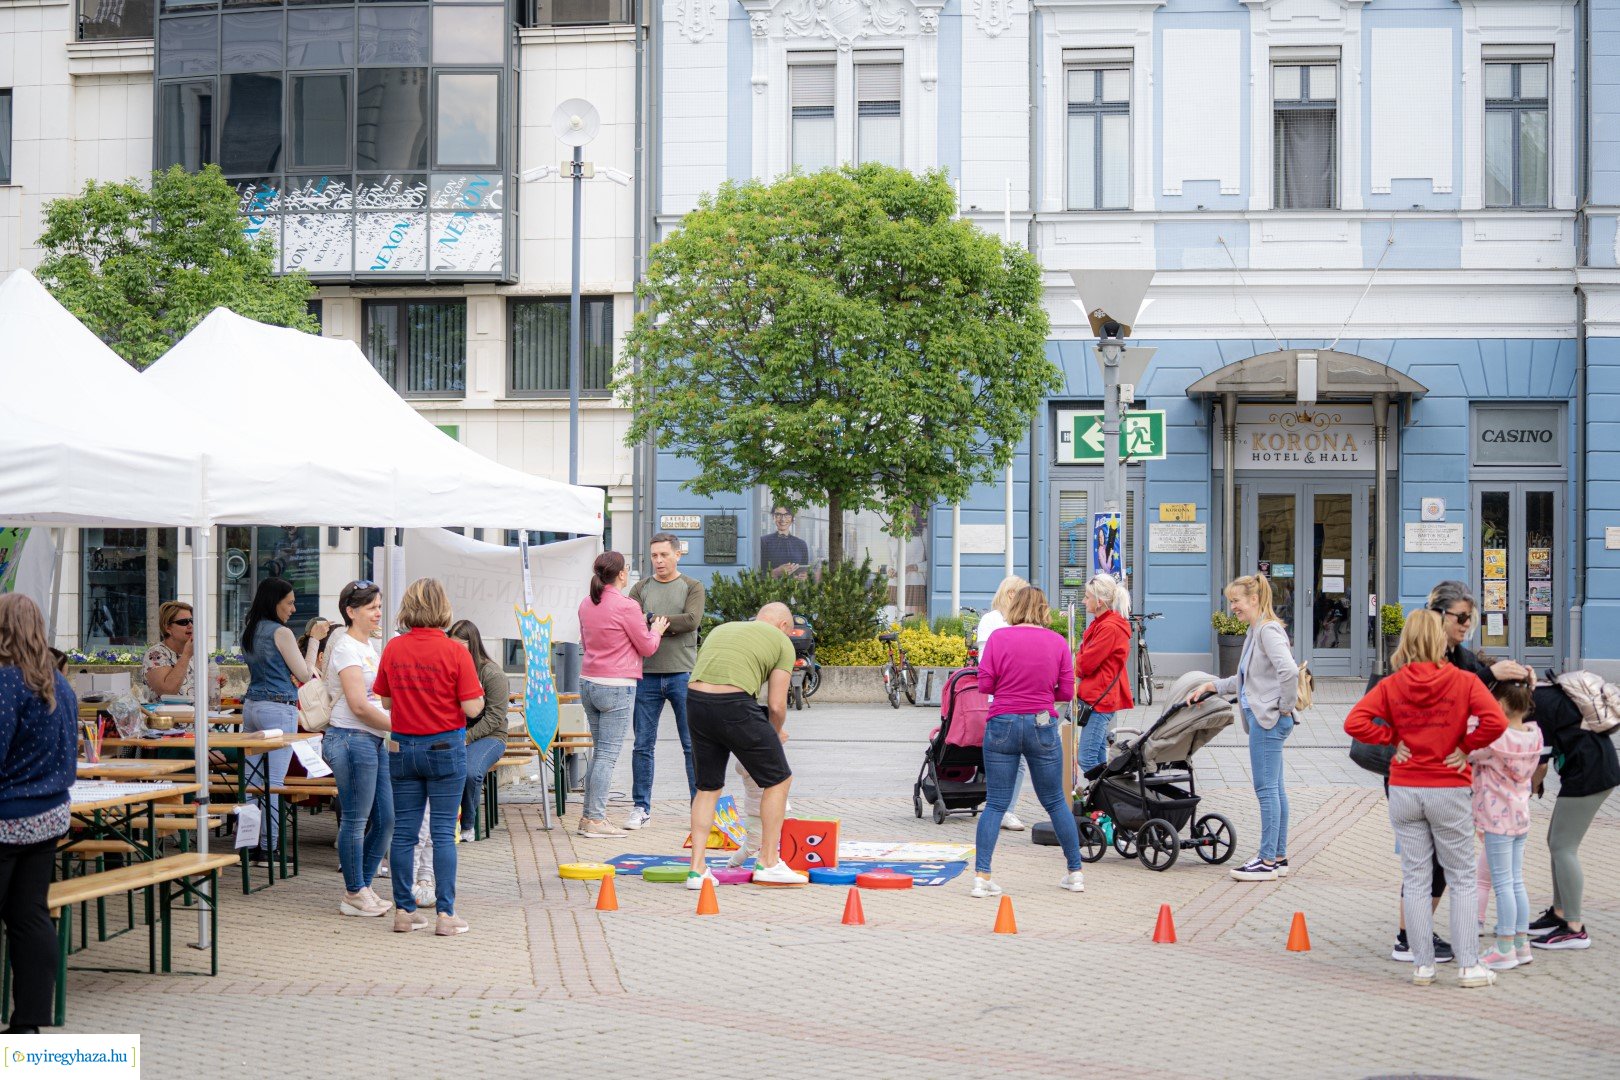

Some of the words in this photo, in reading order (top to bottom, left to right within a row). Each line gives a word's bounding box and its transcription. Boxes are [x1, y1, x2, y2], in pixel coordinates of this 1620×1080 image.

[239, 182, 257, 213] EXON
[314, 237, 333, 265] NEXON
[369, 218, 411, 271] NEXON
[1251, 431, 1358, 452] KORONA
[1481, 429, 1553, 443] CASINO
[1252, 452, 1300, 462] HOTEL
[1304, 451, 1317, 464] &
[1319, 453, 1358, 462] HALL
